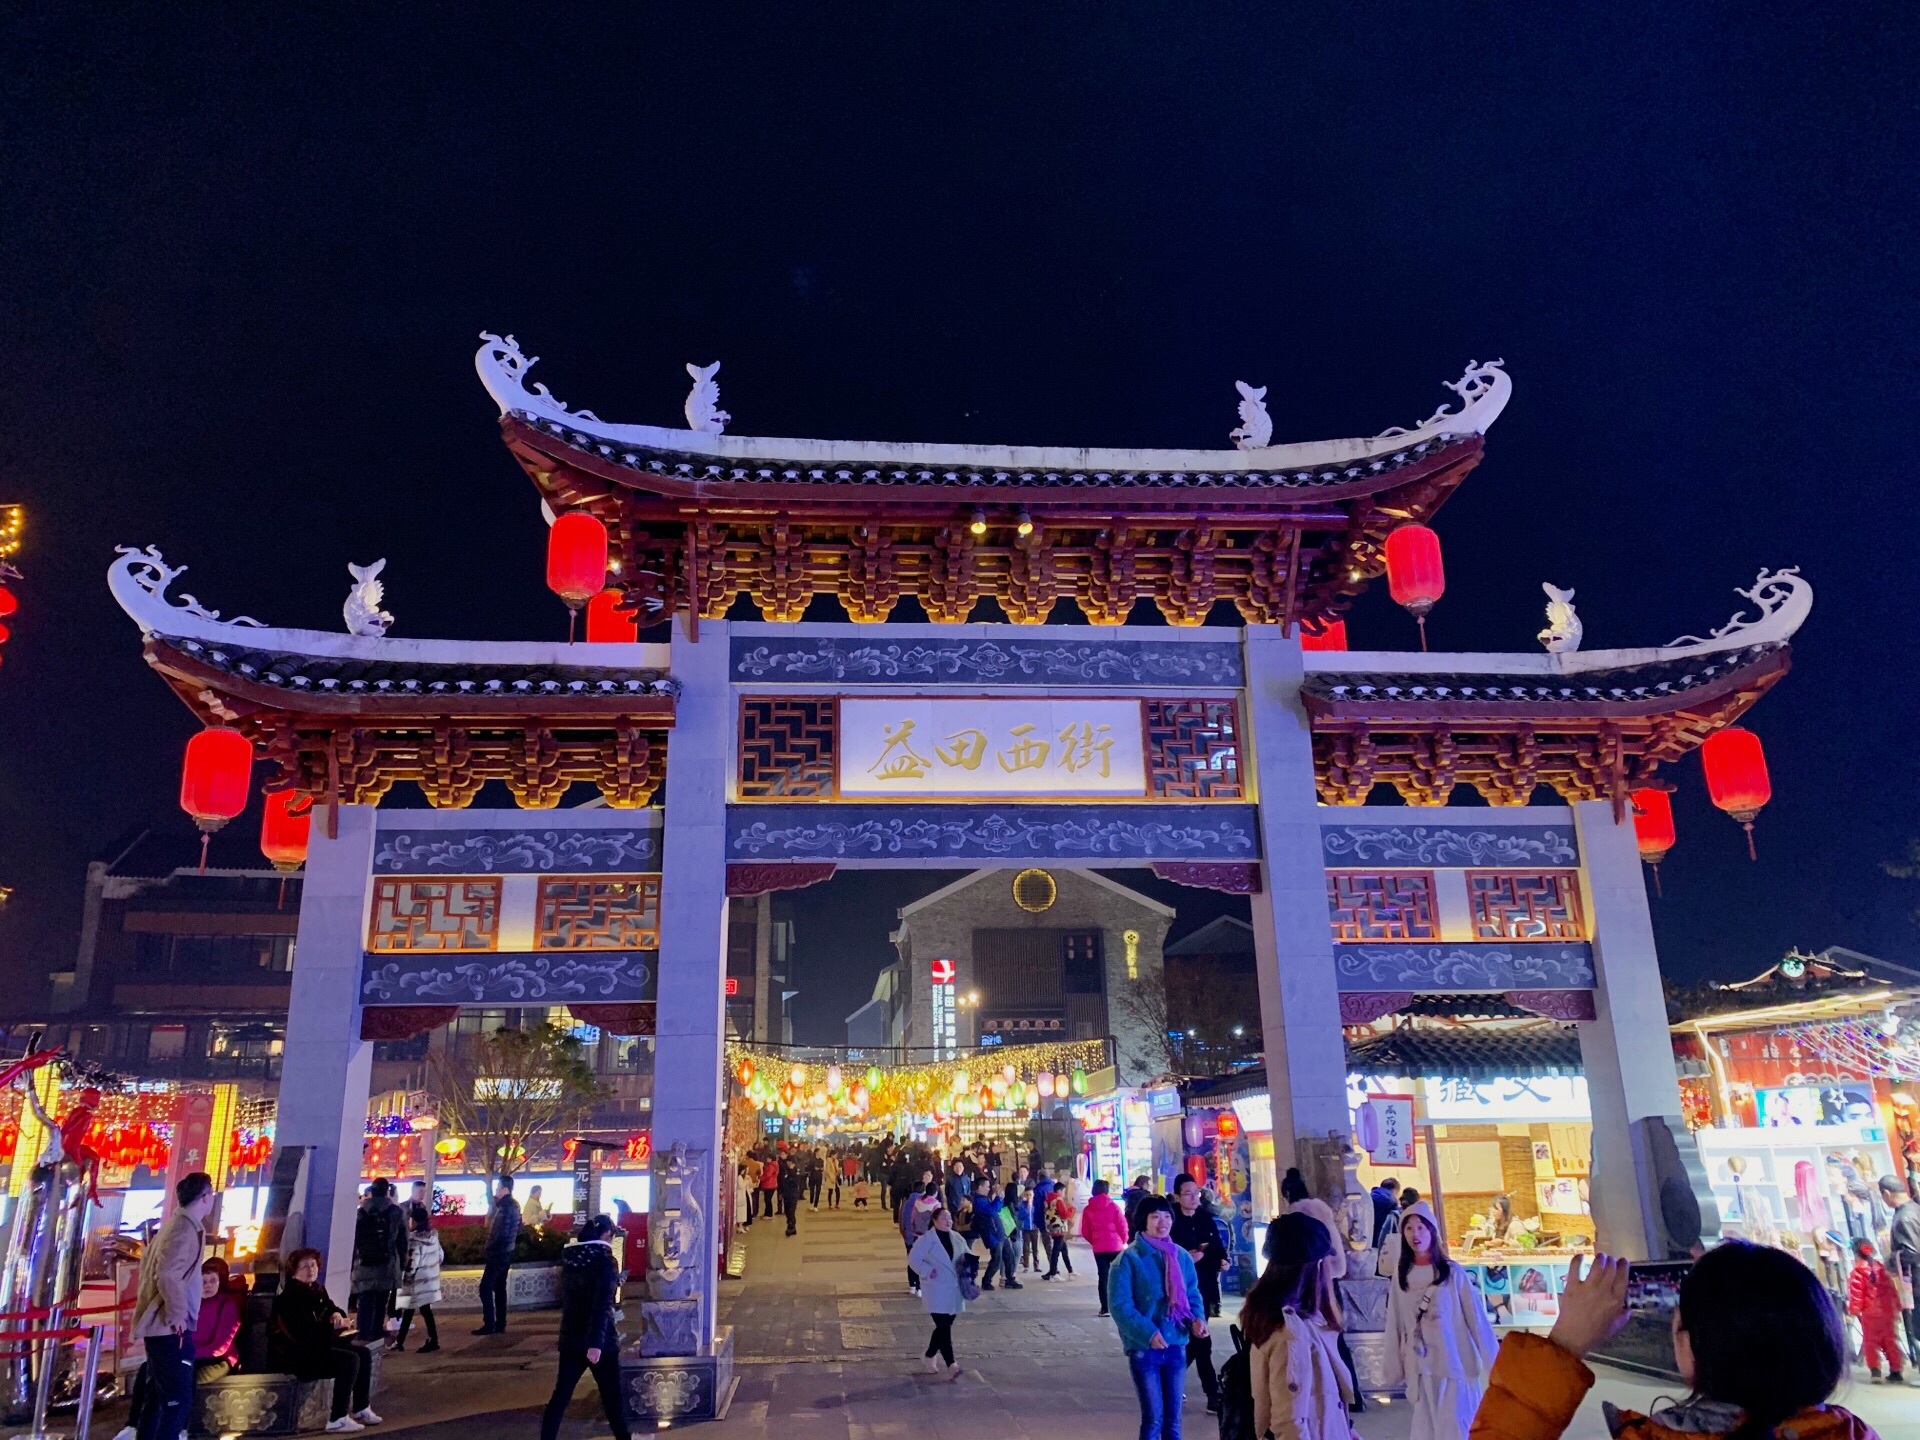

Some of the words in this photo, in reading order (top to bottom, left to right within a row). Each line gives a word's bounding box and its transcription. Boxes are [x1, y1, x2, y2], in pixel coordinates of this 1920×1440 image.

[867, 719, 1116, 780] 益田西街
[573, 1159, 589, 1225] 一元幸运
